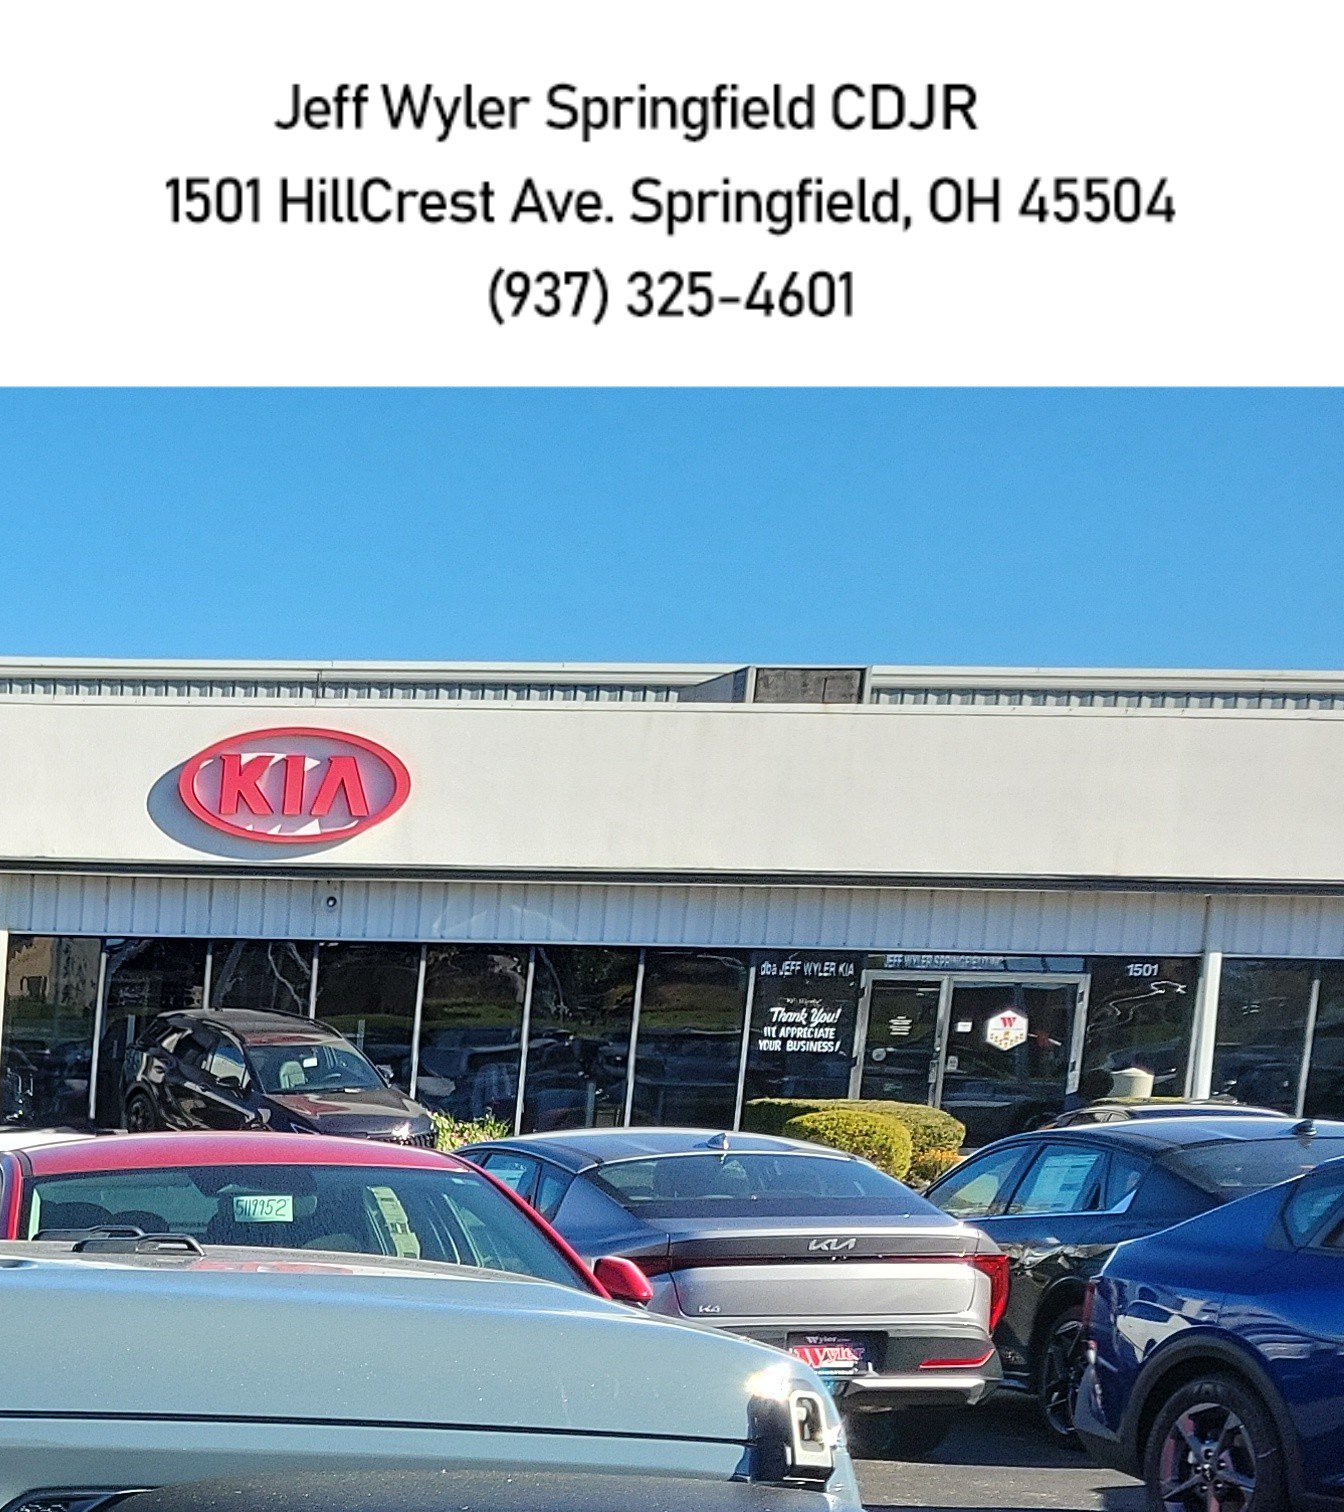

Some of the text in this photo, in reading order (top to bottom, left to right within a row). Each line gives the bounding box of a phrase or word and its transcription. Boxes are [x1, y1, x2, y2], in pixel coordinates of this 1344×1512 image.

[219, 753, 370, 817] KIA
[779, 960, 802, 976] JEFF
[803, 961, 837, 977] WYLER
[838, 962, 855, 977] KIA
[1127, 963, 1160, 977] 1501
[769, 1006, 842, 1028] Thank You!
[779, 1026, 836, 1039] APPRECIATE
[758, 1039, 842, 1053] YOUR BUSINESS!
